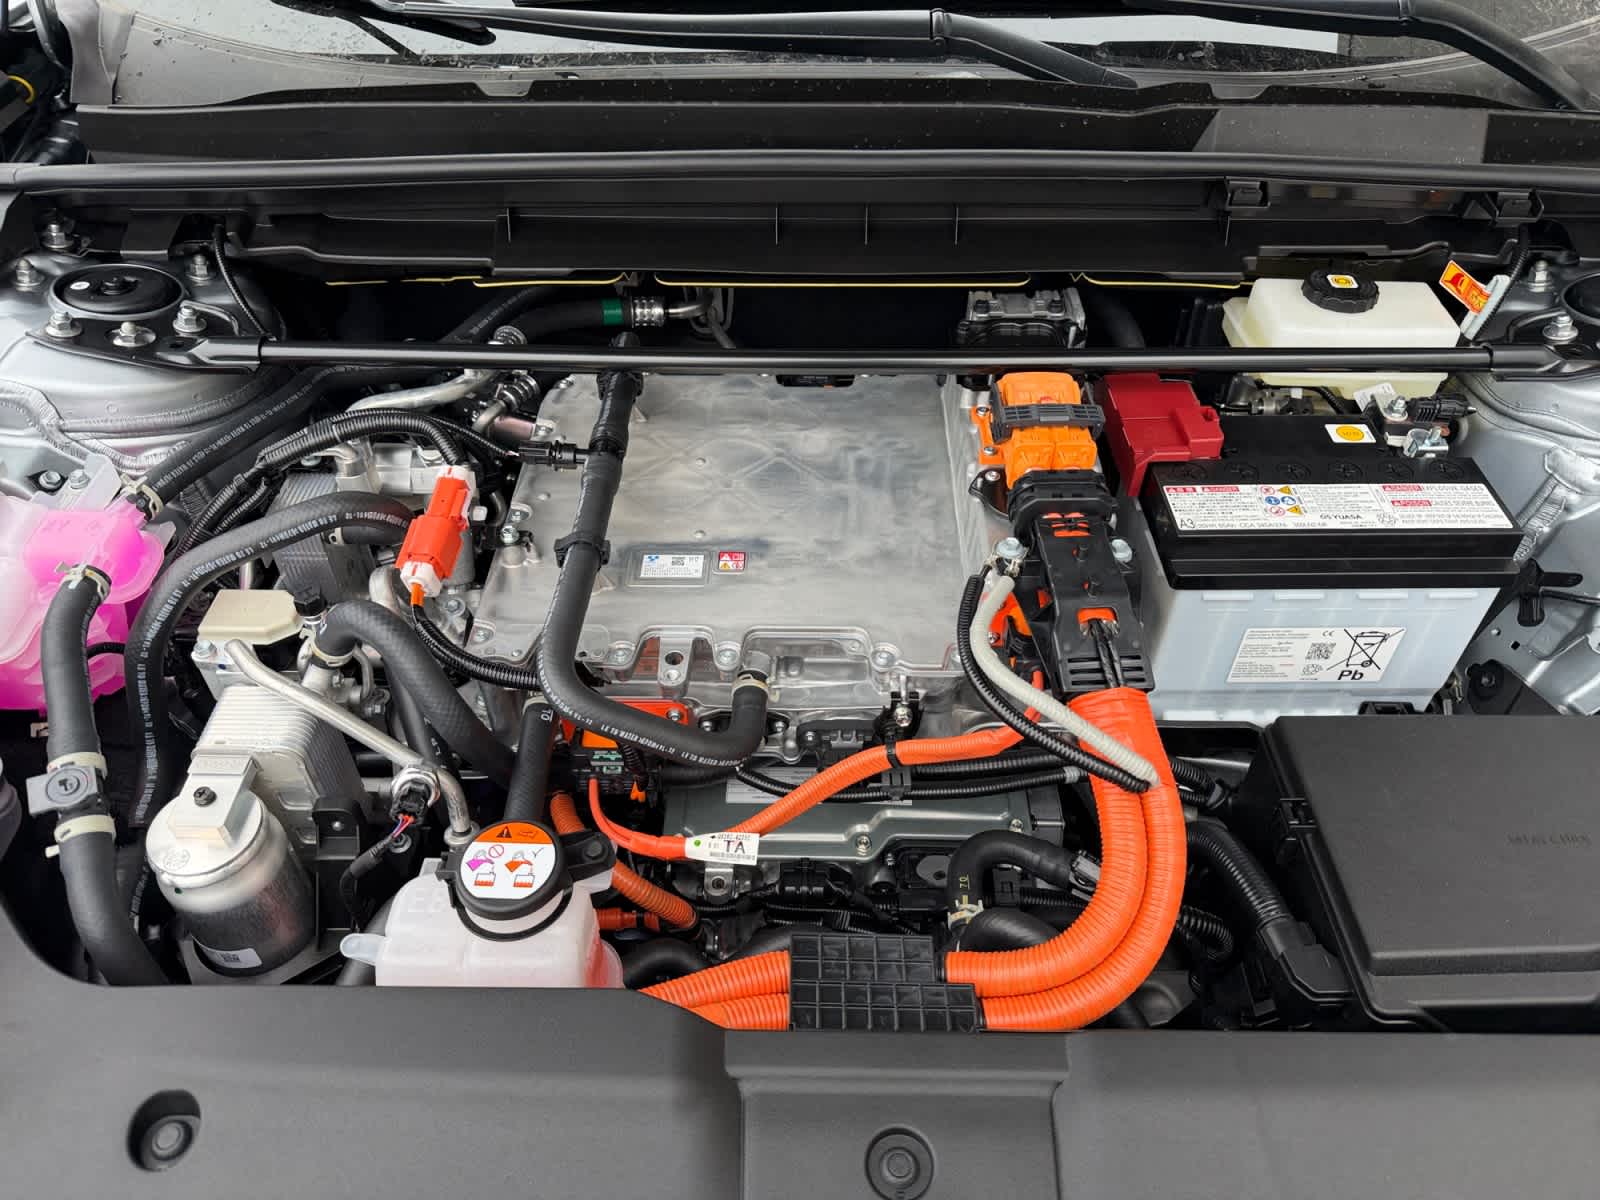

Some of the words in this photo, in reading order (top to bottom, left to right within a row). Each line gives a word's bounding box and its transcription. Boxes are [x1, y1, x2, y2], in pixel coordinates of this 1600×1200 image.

[1180, 517, 1195, 528] A3
[1337, 669, 1364, 681] Pb
[723, 839, 746, 854] TA
